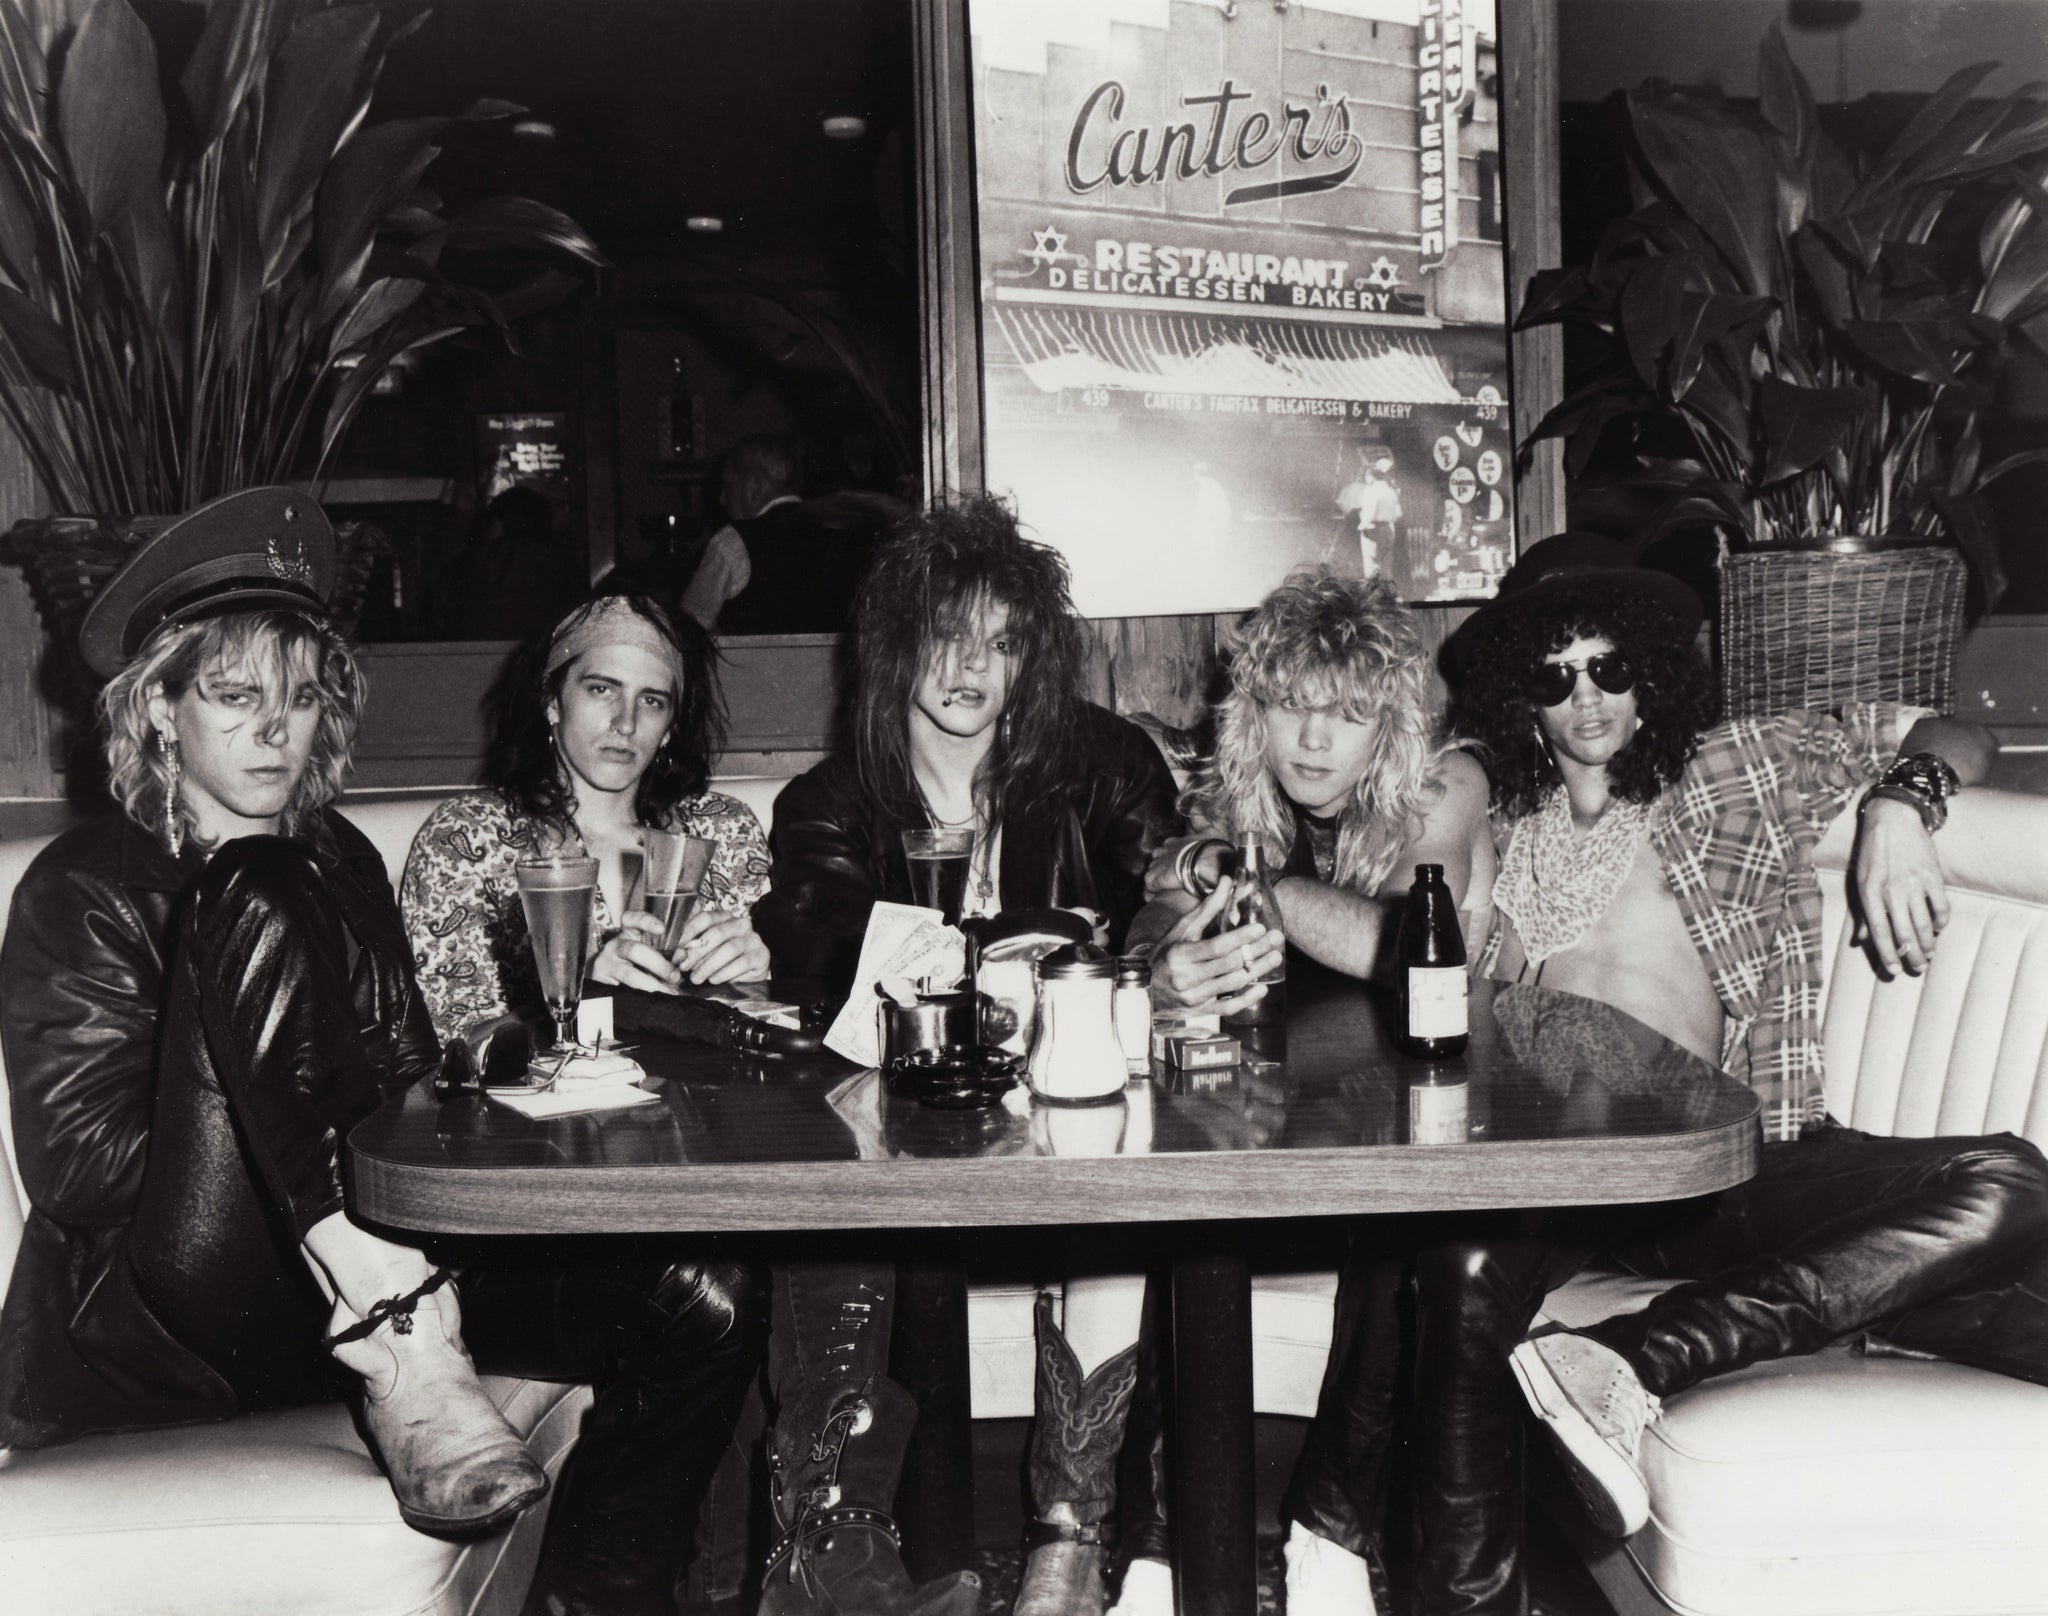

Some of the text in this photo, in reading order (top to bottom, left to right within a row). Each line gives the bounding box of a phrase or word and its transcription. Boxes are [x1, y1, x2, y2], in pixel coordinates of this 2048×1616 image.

[1065, 80, 1363, 205] Canter's
[1096, 239, 1349, 289] RESTAURANT
[1050, 267, 1390, 311] DELICATESSEN BAKERY
[1267, 398, 1347, 416] DELICATESSEN
[1353, 403, 1362, 417] &
[1368, 404, 1412, 418] BAKERY
[1476, 405, 1498, 420] 439
[1191, 1045, 1232, 1066] Marlboro
